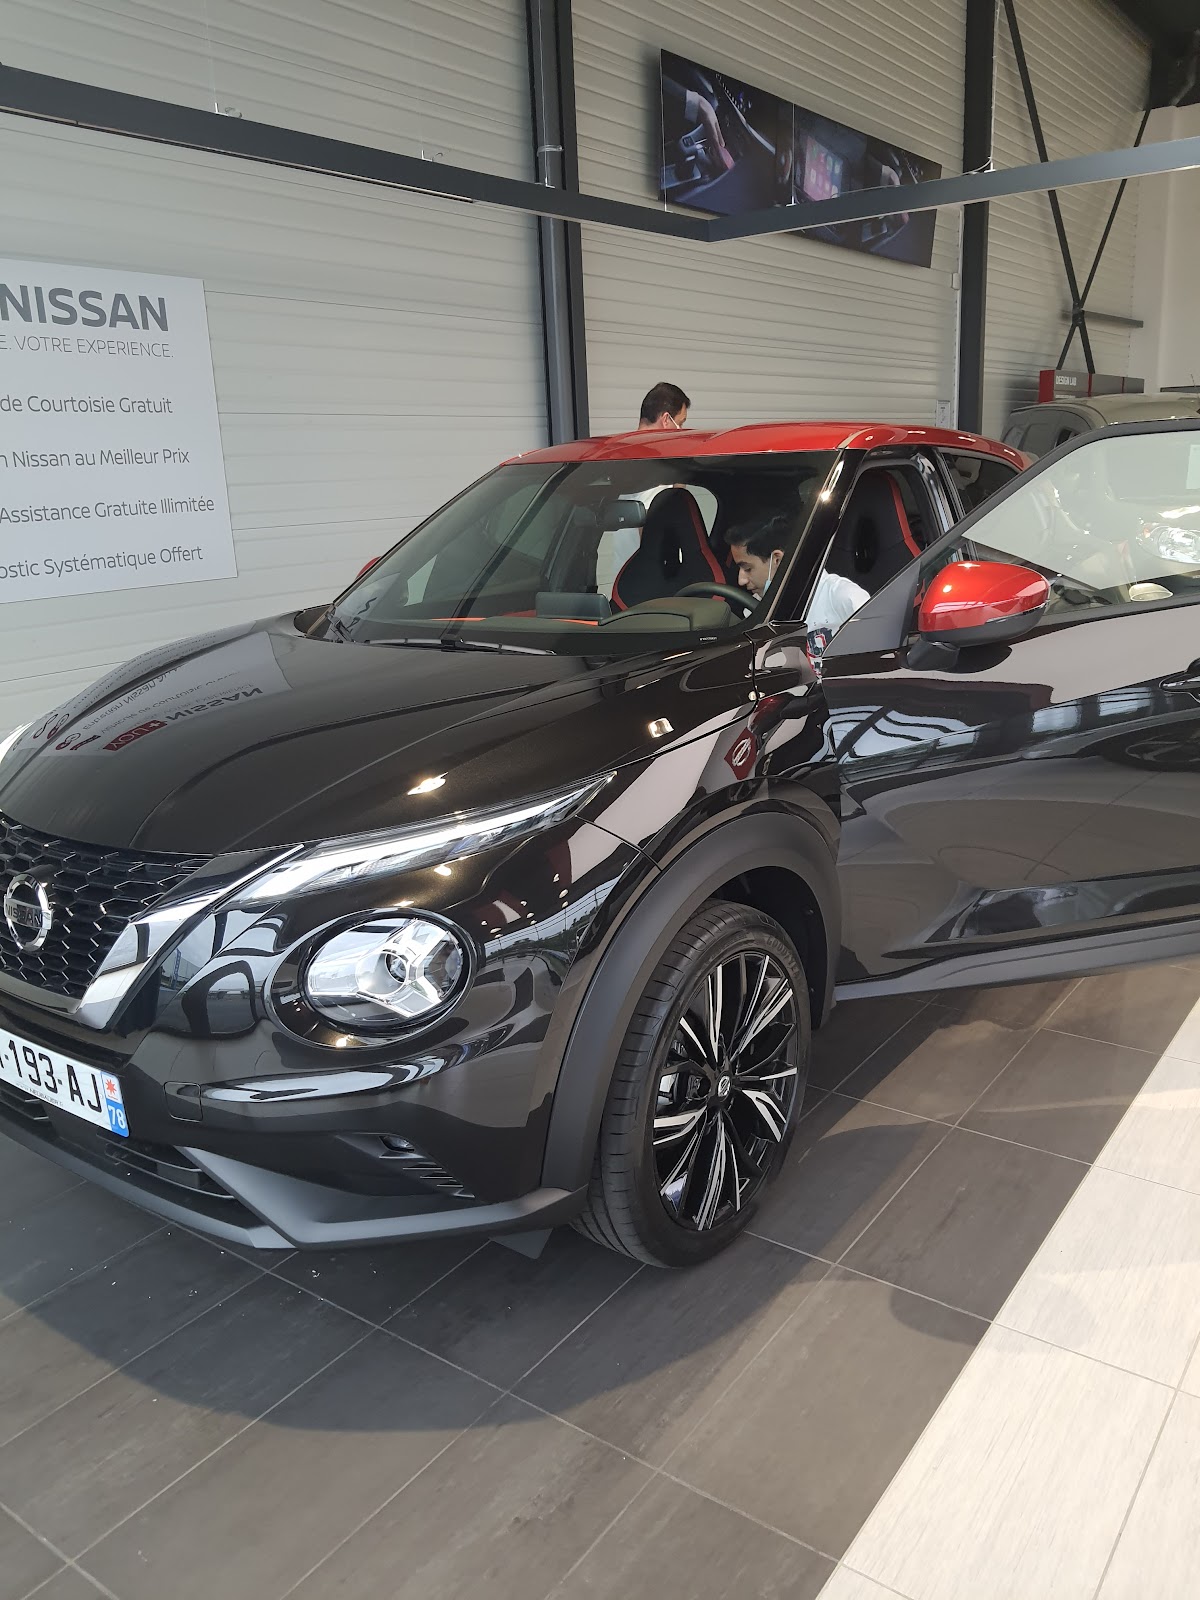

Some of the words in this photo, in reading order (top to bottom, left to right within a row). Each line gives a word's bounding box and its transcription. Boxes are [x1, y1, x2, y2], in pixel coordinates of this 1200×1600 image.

[0, 283, 168, 332] NISSAN
[14, 335, 73, 353] VOTRE
[76, 338, 174, 358] EXPERIENCE.
[0, 394, 23, 412] de
[27, 395, 116, 413] Courtoisie
[119, 397, 173, 413] Gratuit
[12, 450, 71, 468] Nissan
[74, 453, 96, 466] au
[100, 448, 159, 466] Meilleur
[162, 447, 190, 464] Prix
[0, 505, 91, 524] Assistance
[94, 500, 158, 518] Gratuite
[160, 495, 215, 514] Illimitée
[43, 551, 157, 578] Systématique
[159, 545, 204, 563] Offert
[108, 1106, 126, 1129] 78
